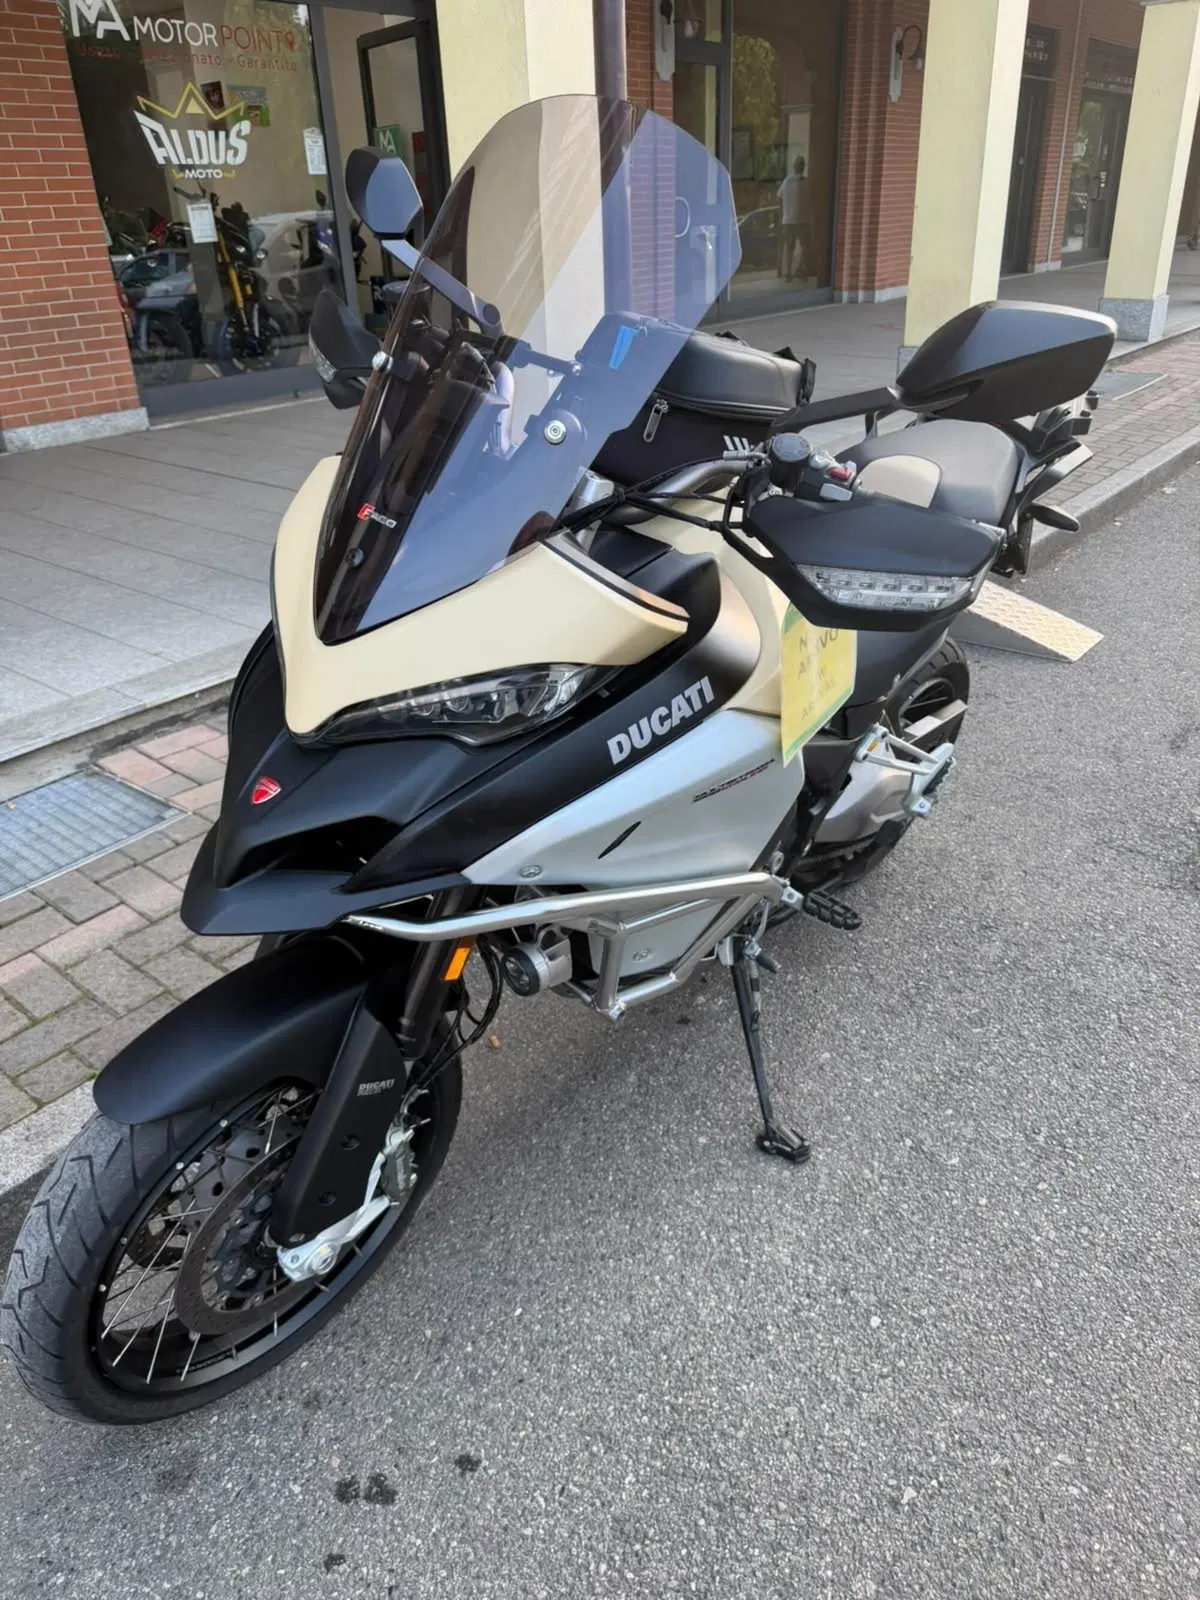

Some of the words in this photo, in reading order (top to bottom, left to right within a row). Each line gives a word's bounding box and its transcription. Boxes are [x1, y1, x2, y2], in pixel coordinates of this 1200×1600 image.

[133, 109, 251, 165] ALDUS
[184, 168, 223, 179] MOTO
[606, 675, 715, 765] DUCATI
[358, 1078, 396, 1091] DUCATI
